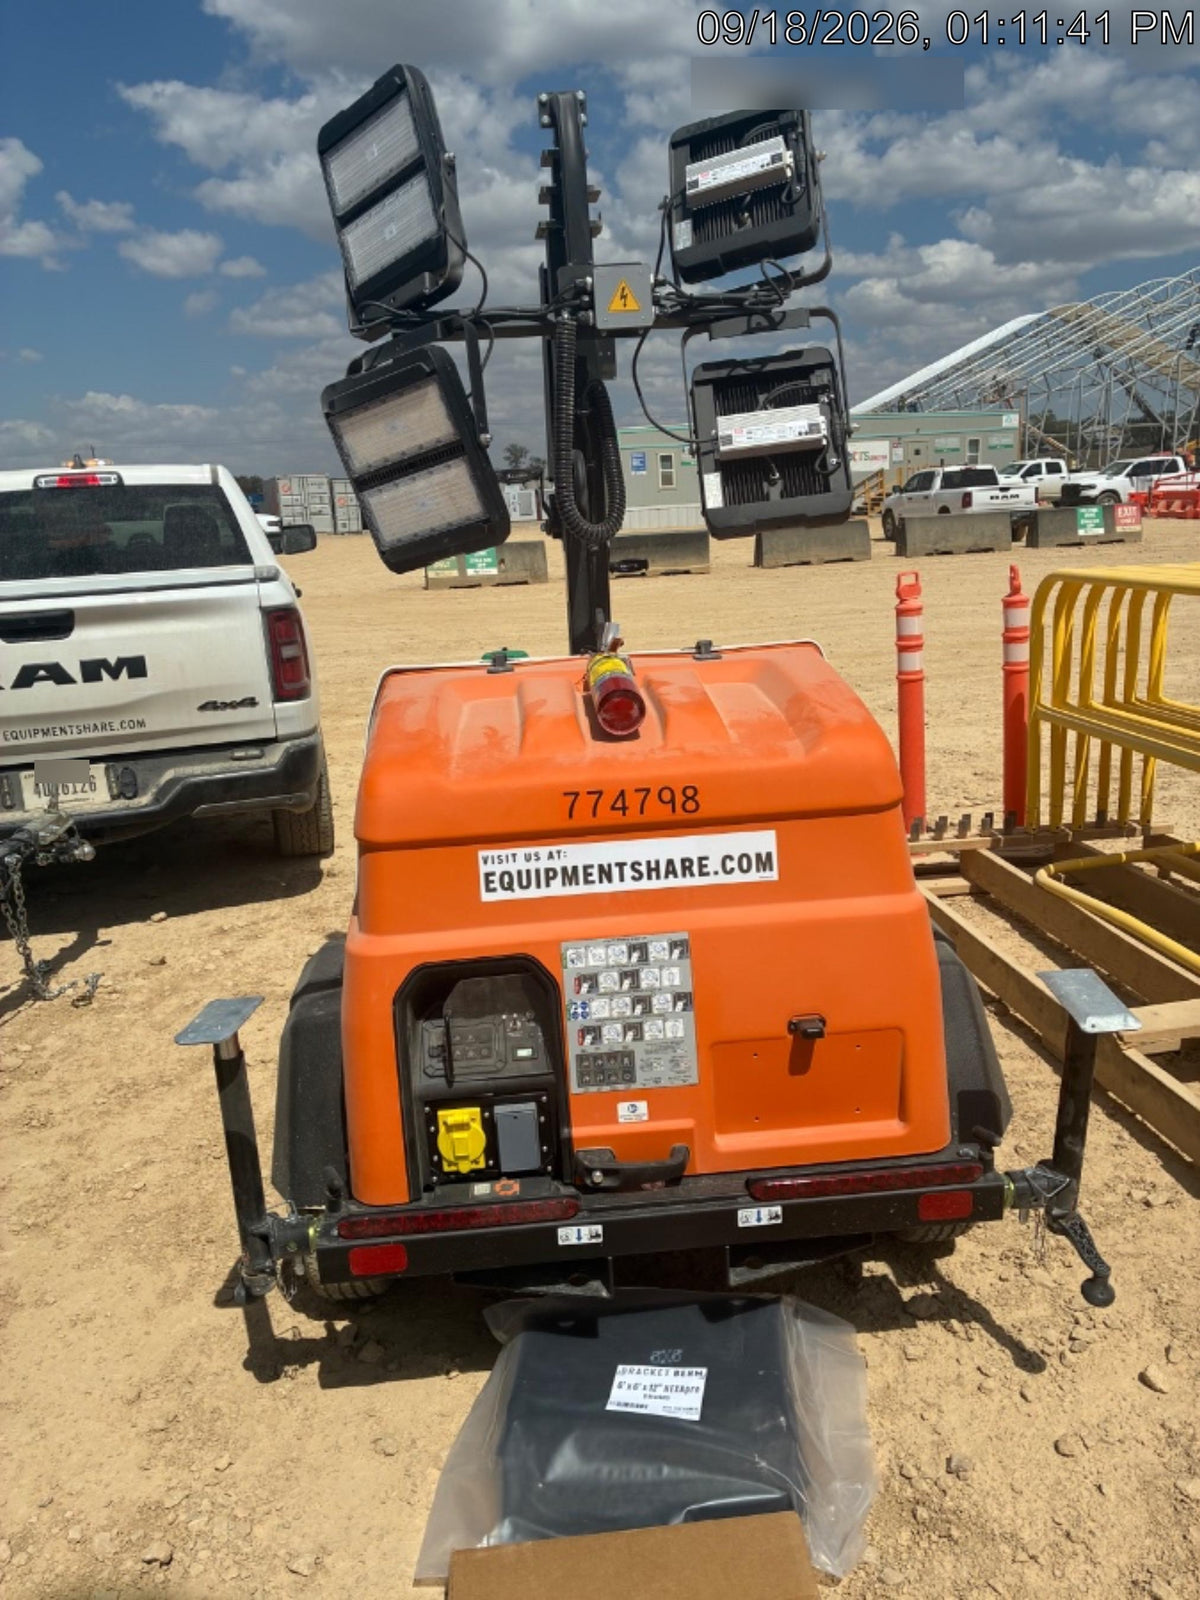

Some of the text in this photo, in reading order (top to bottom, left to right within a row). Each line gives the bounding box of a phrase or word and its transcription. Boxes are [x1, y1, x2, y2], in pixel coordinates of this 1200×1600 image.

[1118, 505, 1138, 517] EXIT
[0, 654, 148, 690] AM
[197, 696, 259, 712] 4x4
[3, 718, 146, 741] EQUIPMENTSHARE.COM
[563, 784, 701, 819] 774798
[481, 848, 568, 866] VISIT US AT:
[483, 851, 774, 893] EQUIPMENTSHARE.COM
